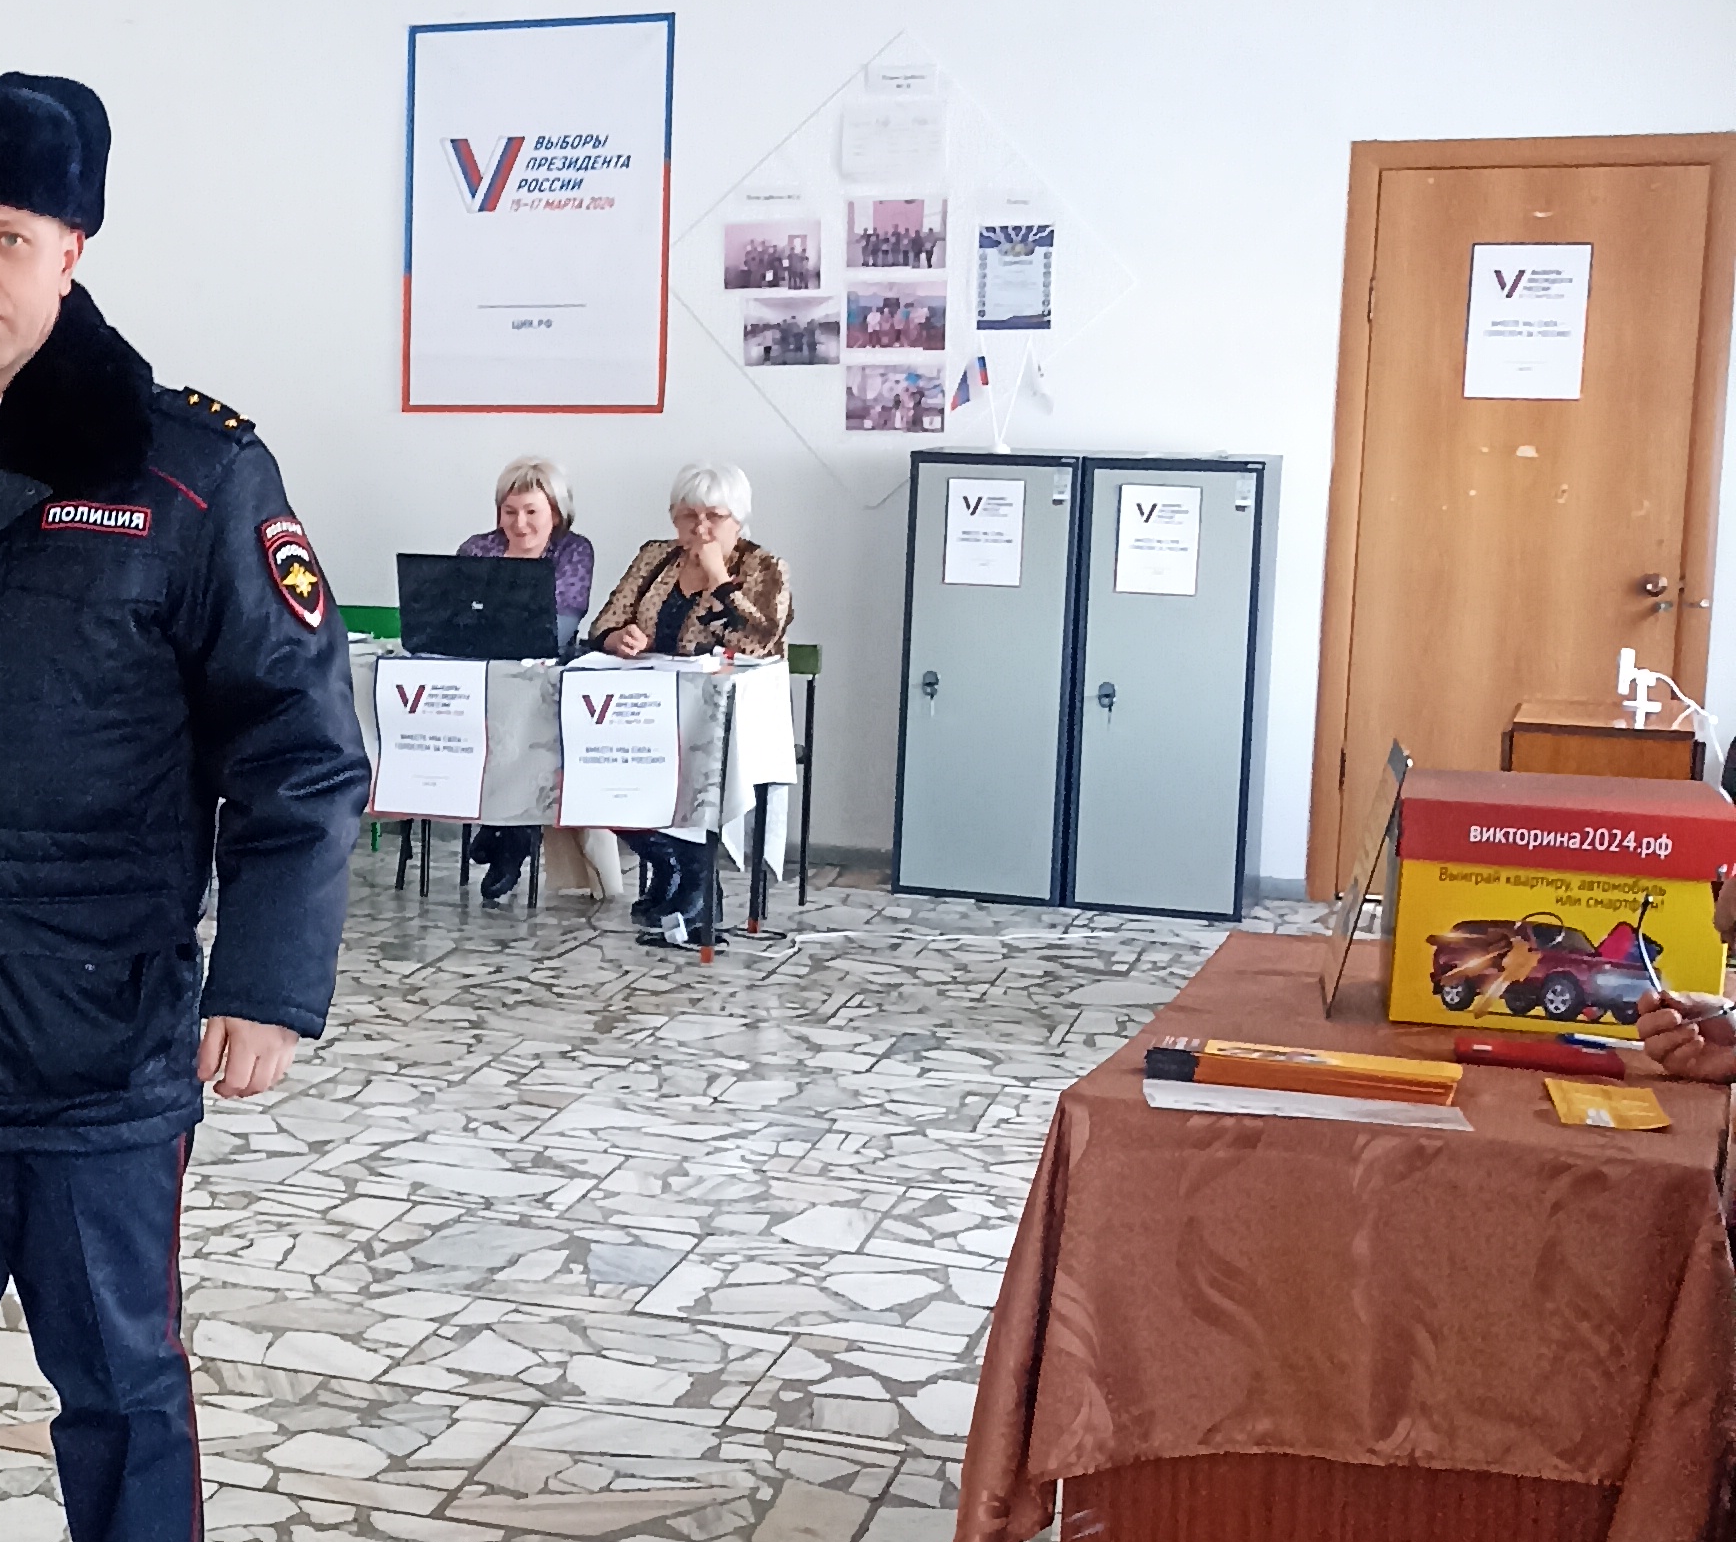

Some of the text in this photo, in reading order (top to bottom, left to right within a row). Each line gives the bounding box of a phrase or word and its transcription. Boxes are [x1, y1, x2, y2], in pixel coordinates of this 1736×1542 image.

[533, 134, 609, 151] ВЫБОРЫ
[525, 154, 632, 173] ПРЕЗИДЕНТА
[516, 177, 585, 193] РОССИИ
[543, 197, 584, 210] МАРТА
[47, 506, 146, 530] ПОЛИЦИЯ
[1469, 825, 1673, 858] викторина2024.рф
